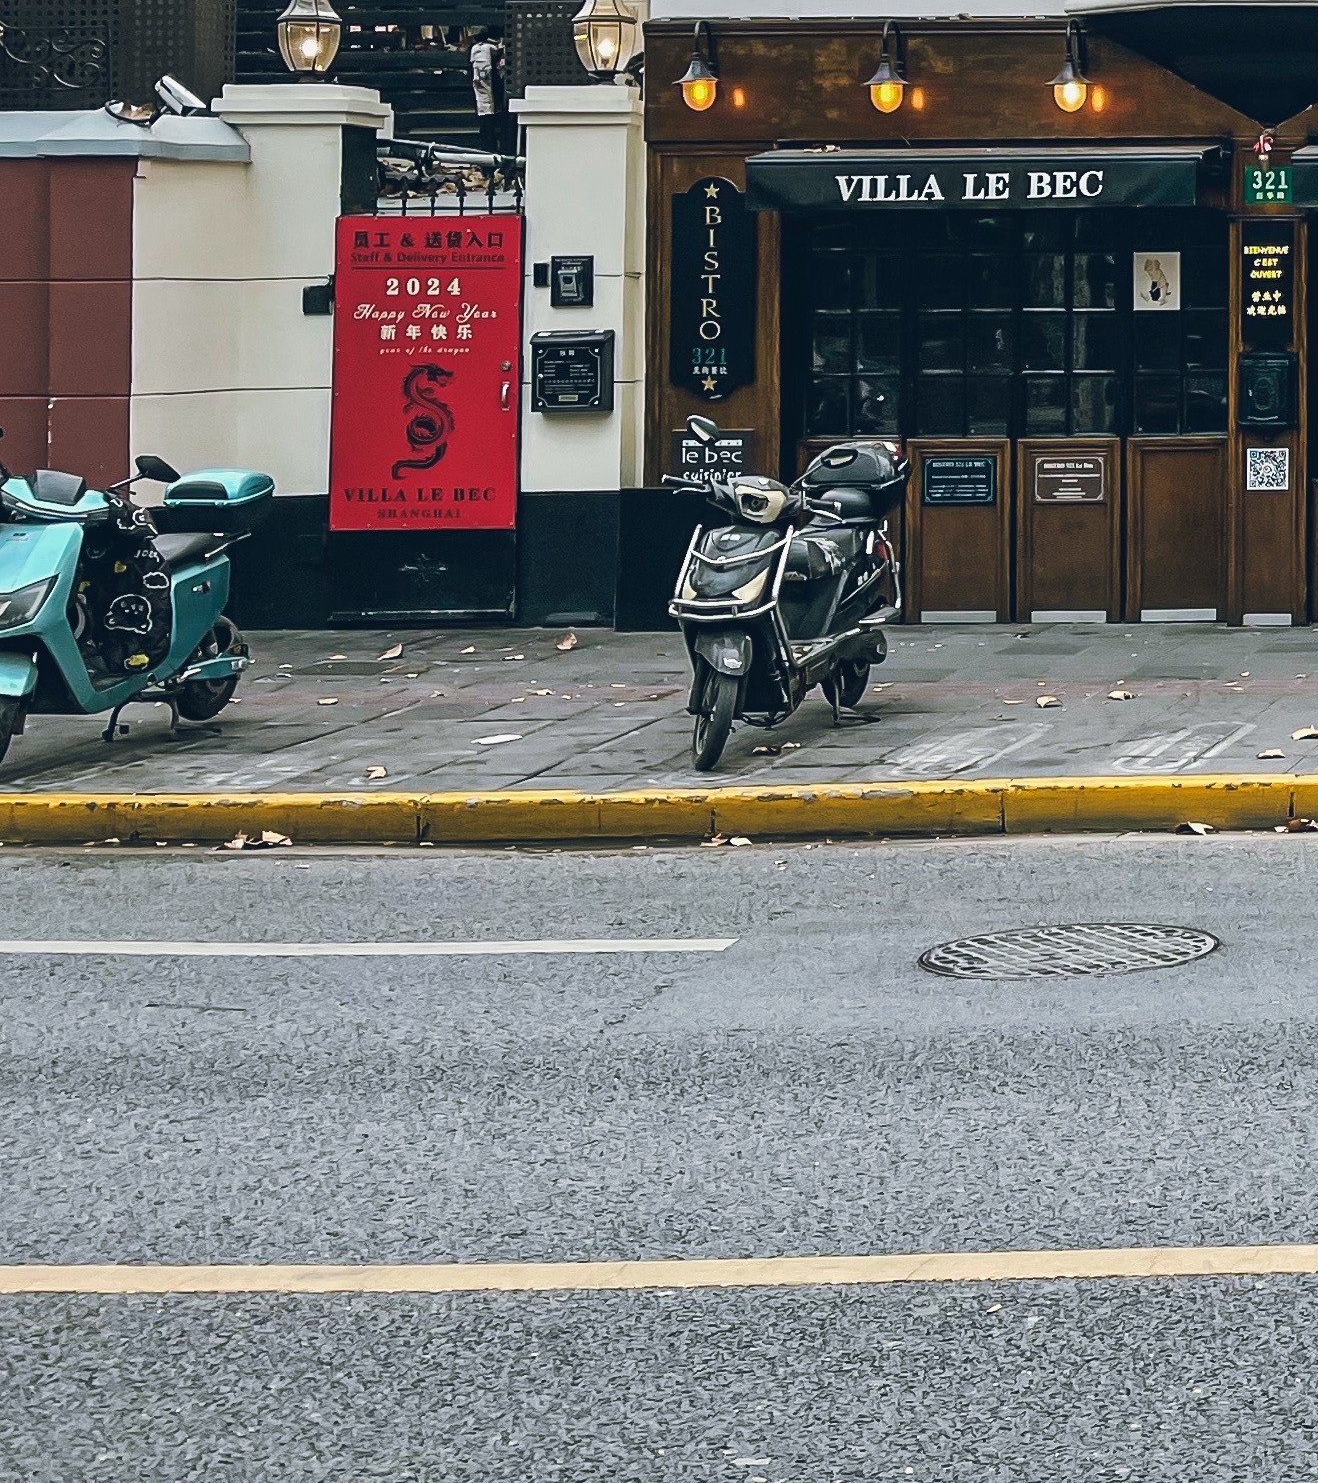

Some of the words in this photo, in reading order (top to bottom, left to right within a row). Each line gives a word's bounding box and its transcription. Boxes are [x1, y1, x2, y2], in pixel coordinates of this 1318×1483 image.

[834, 173, 946, 202] VILLA
[961, 172, 1010, 200] LE
[1025, 169, 1105, 199] BEC
[1252, 170, 1289, 190] 321
[353, 230, 391, 249] 员工
[399, 232, 416, 248] &
[351, 251, 380, 263] Staff
[382, 252, 393, 263] &
[397, 251, 448, 265] Delivery
[451, 251, 506, 263] Entrance
[699, 205, 723, 341] BISTRO
[385, 277, 462, 297] 2024
[353, 303, 406, 324] Happy
[411, 303, 451, 320] New
[455, 302, 498, 324] Year
[379, 323, 473, 341] 新年快乐
[691, 347, 728, 365] 321
[681, 447, 699, 463] le
[704, 446, 743, 463] bec
[344, 486, 408, 503] VILLA
[416, 487, 444, 503] LE
[453, 486, 497, 503] BEC
[376, 508, 462, 519] SHANGHAI
